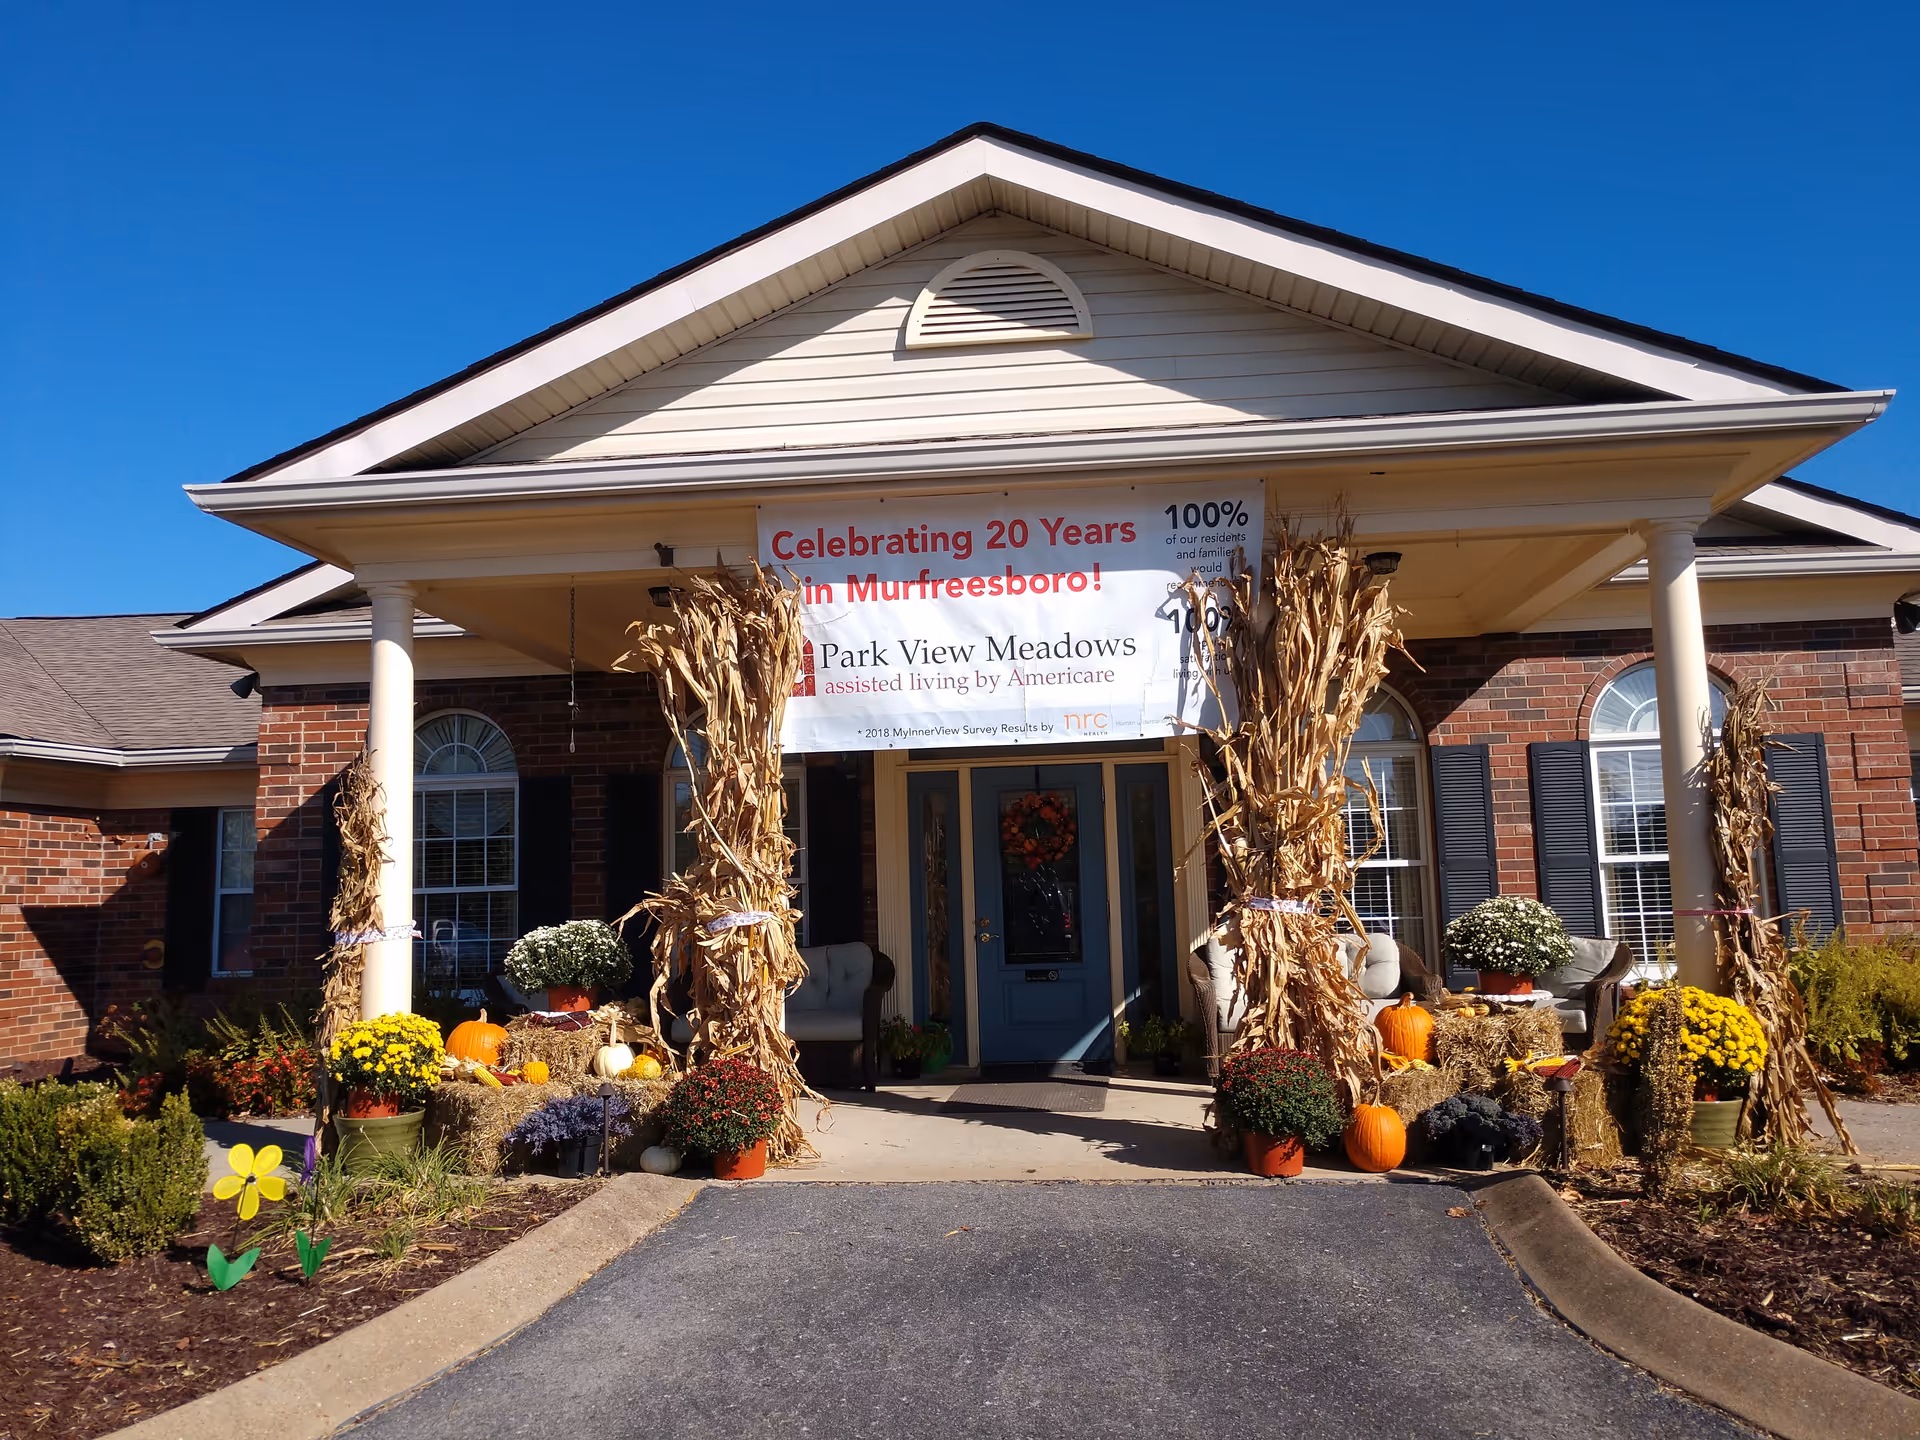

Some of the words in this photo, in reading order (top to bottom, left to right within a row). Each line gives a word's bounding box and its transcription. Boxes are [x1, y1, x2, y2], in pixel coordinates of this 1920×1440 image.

[1164, 500, 1249, 530] 100%
[771, 523, 973, 561] Celebrating
[986, 519, 1029, 550] 20
[1039, 516, 1137, 547] Years
[1165, 534, 1177, 545] of
[1179, 536, 1198, 545] our
[1200, 531, 1247, 544] residents
[1176, 548, 1196, 560] and
[1190, 562, 1222, 574] would
[804, 576, 834, 605] in
[846, 562, 1102, 603] Murfreesboro!
[819, 640, 890, 669] Park
[897, 639, 976, 665] View
[985, 632, 1137, 662] Meadows
[824, 673, 902, 695] assisted
[909, 672, 970, 695] living
[974, 670, 1002, 694] by
[1007, 667, 1116, 687] Americare
[1173, 669, 1199, 680] living
[1063, 712, 1108, 730] nrc
[865, 728, 890, 738] 2018
[893, 726, 960, 739] MyInnerView
[962, 724, 998, 735] Survey
[1001, 722, 1038, 733] Results
[1041, 722, 1054, 733] by
